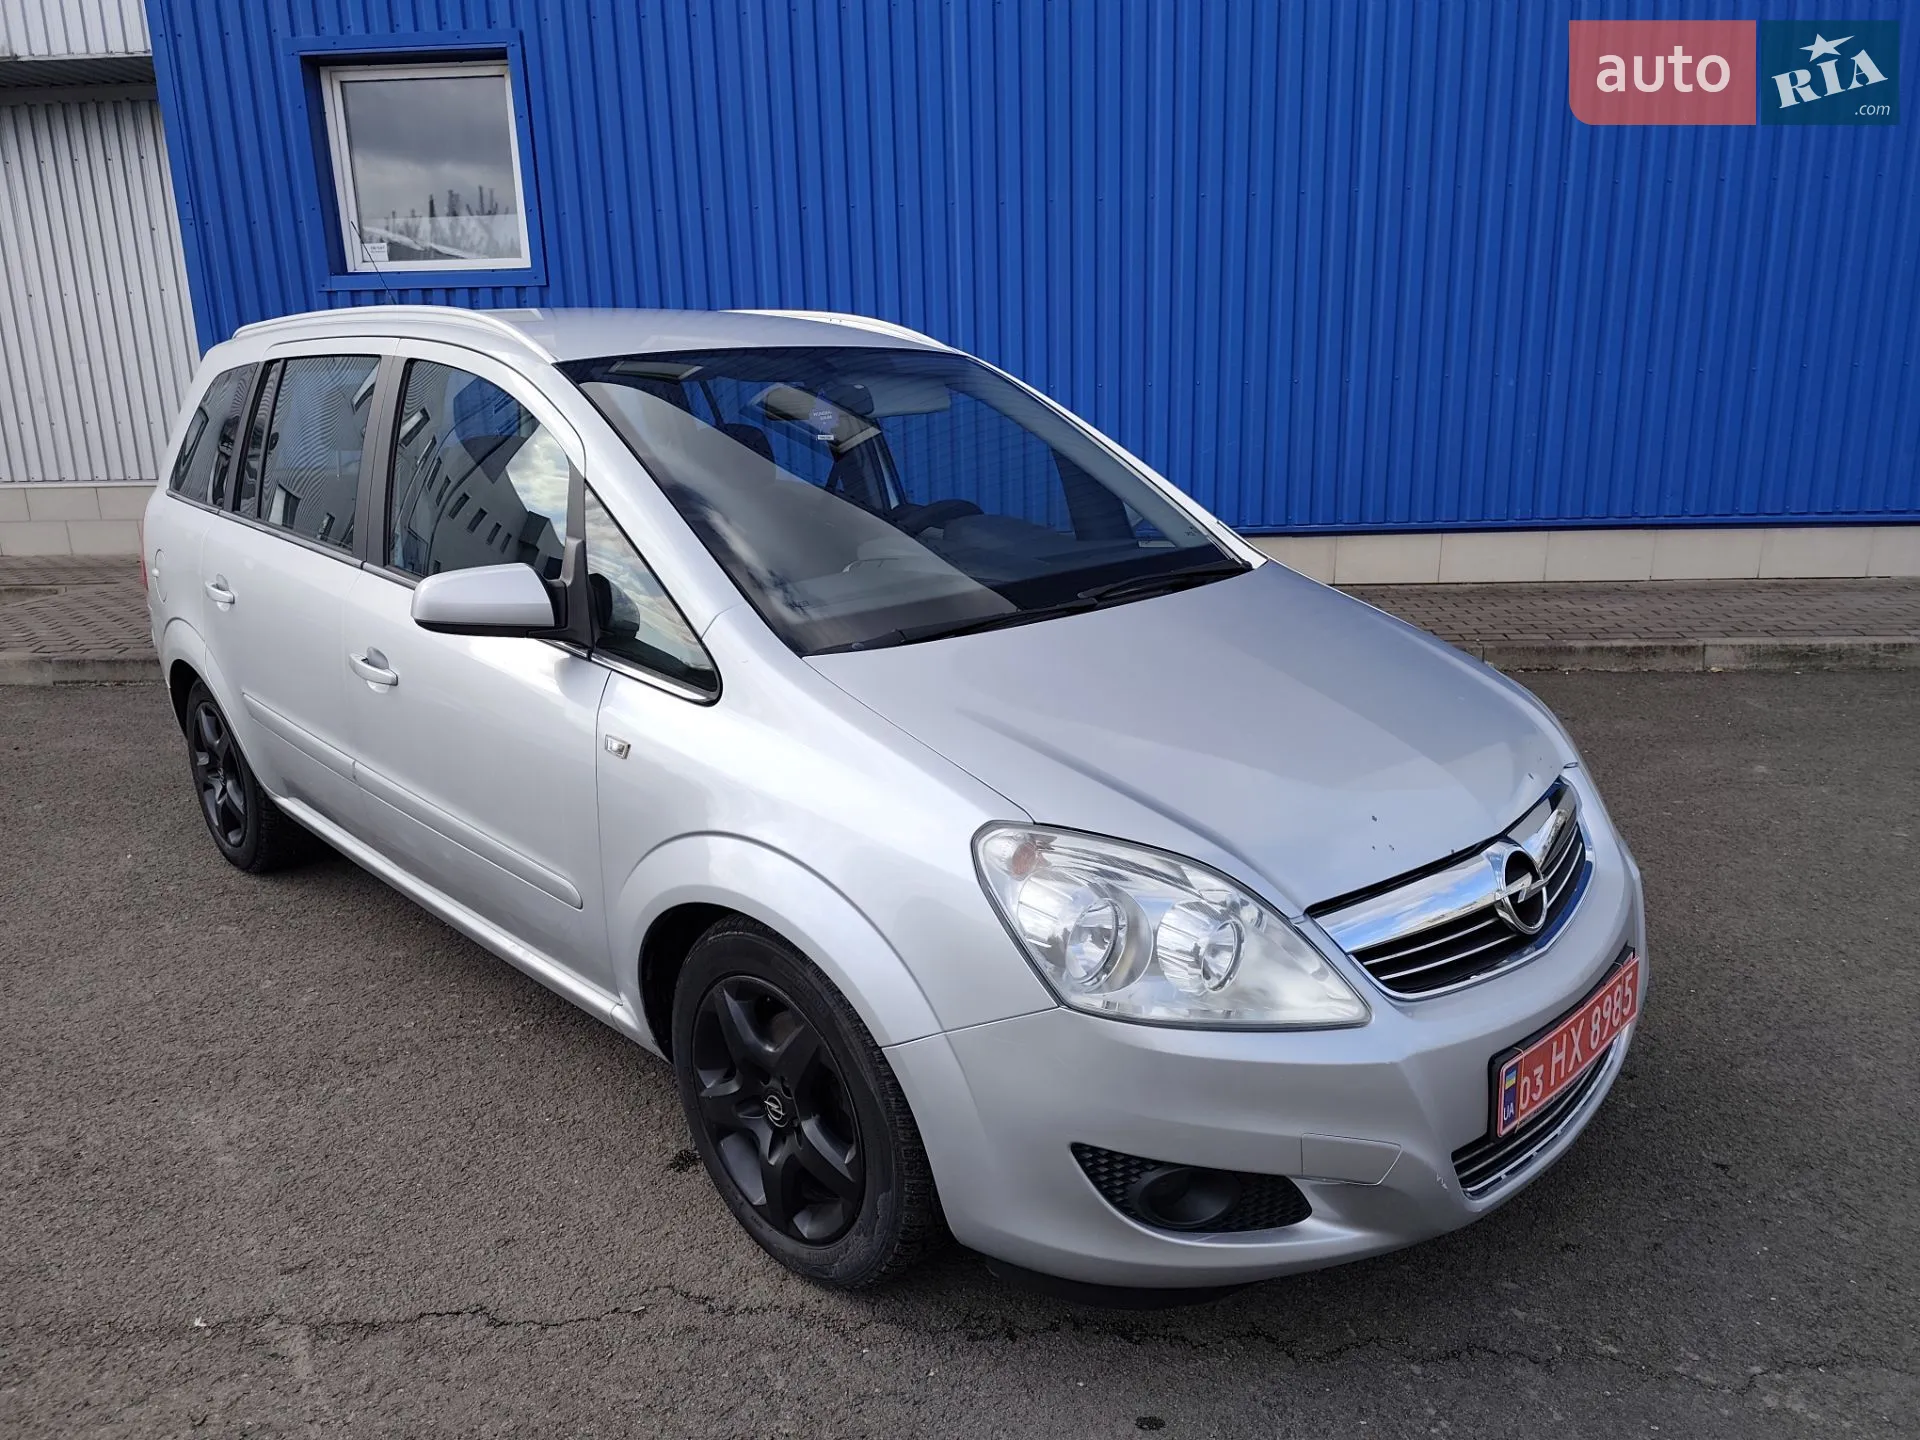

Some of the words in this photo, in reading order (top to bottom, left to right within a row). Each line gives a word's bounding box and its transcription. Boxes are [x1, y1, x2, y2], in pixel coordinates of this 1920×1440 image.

[1550, 1018, 1585, 1086] HX
[1590, 971, 1634, 1051] 8985
[1503, 1102, 1514, 1121] UA
